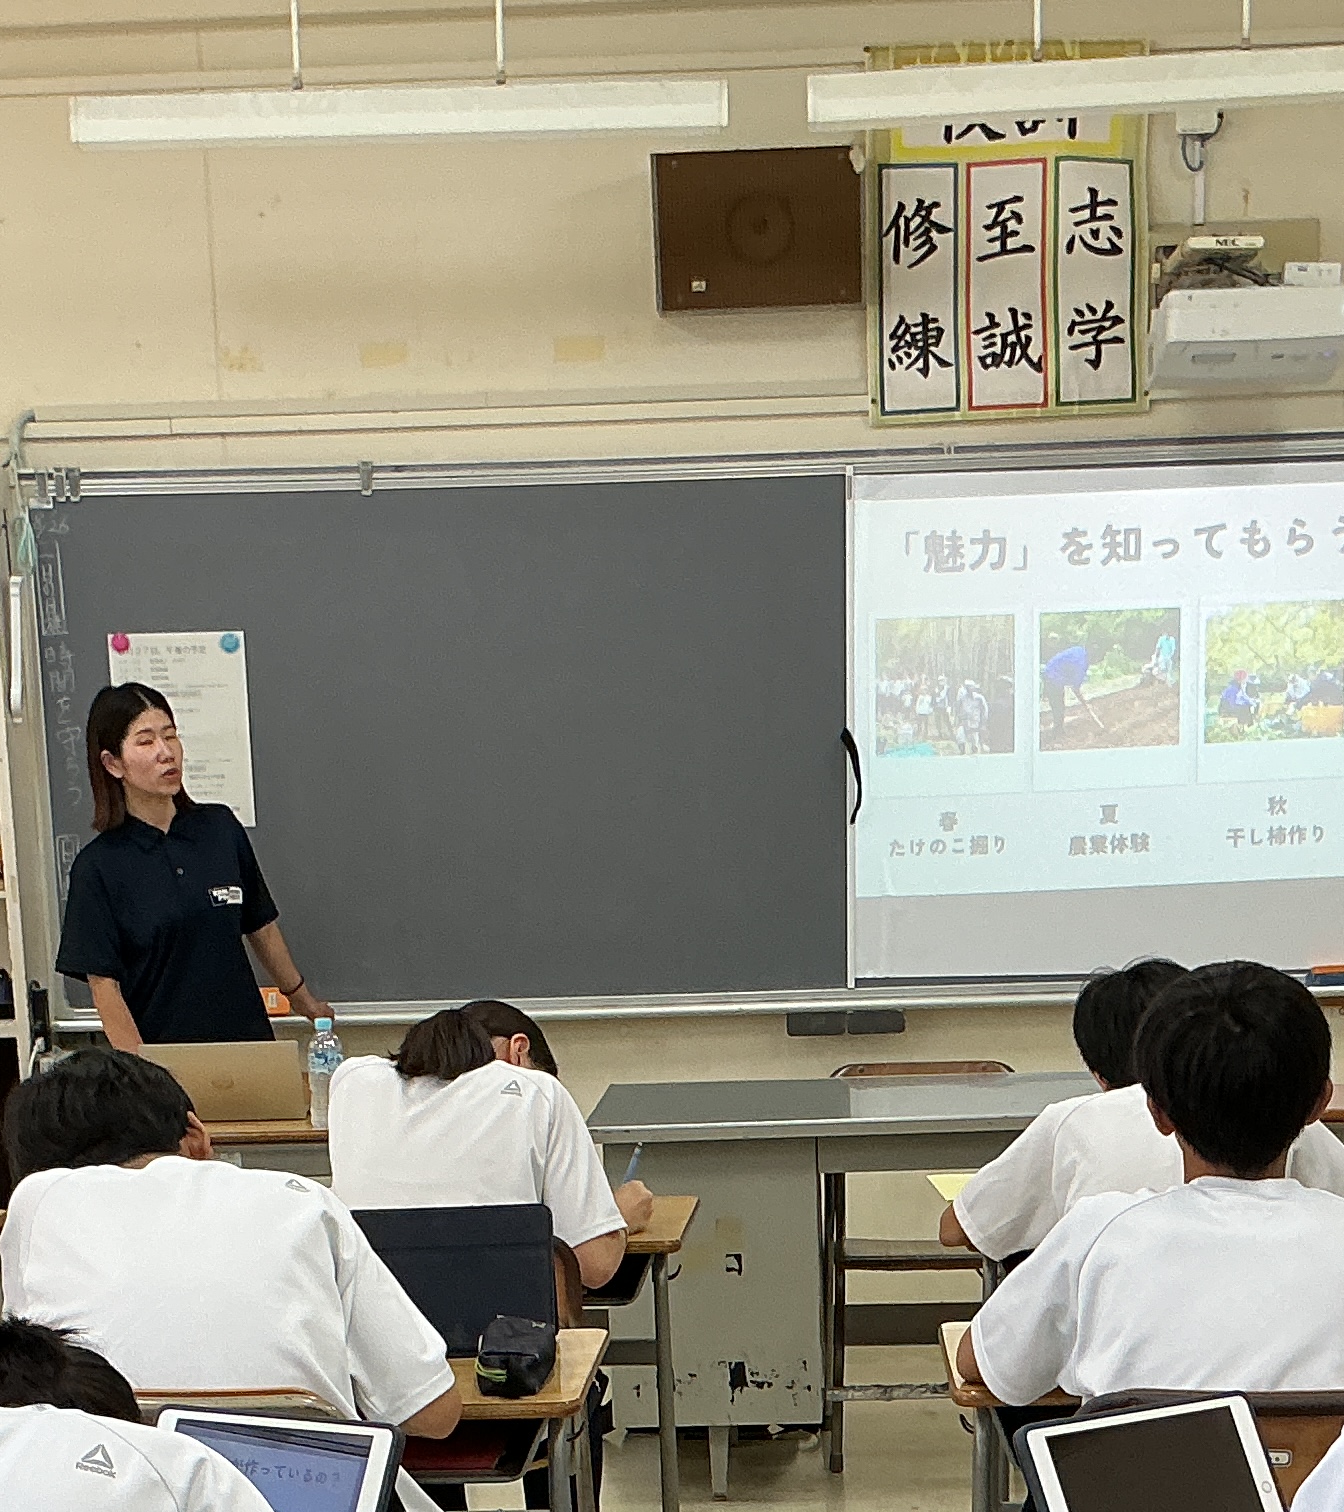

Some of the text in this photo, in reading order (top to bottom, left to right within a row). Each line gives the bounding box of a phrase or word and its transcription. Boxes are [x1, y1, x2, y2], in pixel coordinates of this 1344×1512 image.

[883, 196, 954, 380] 修練
[972, 195, 1043, 374] 至誠
[1066, 187, 1126, 371] 志学
[1267, 795, 1287, 816] 秋
